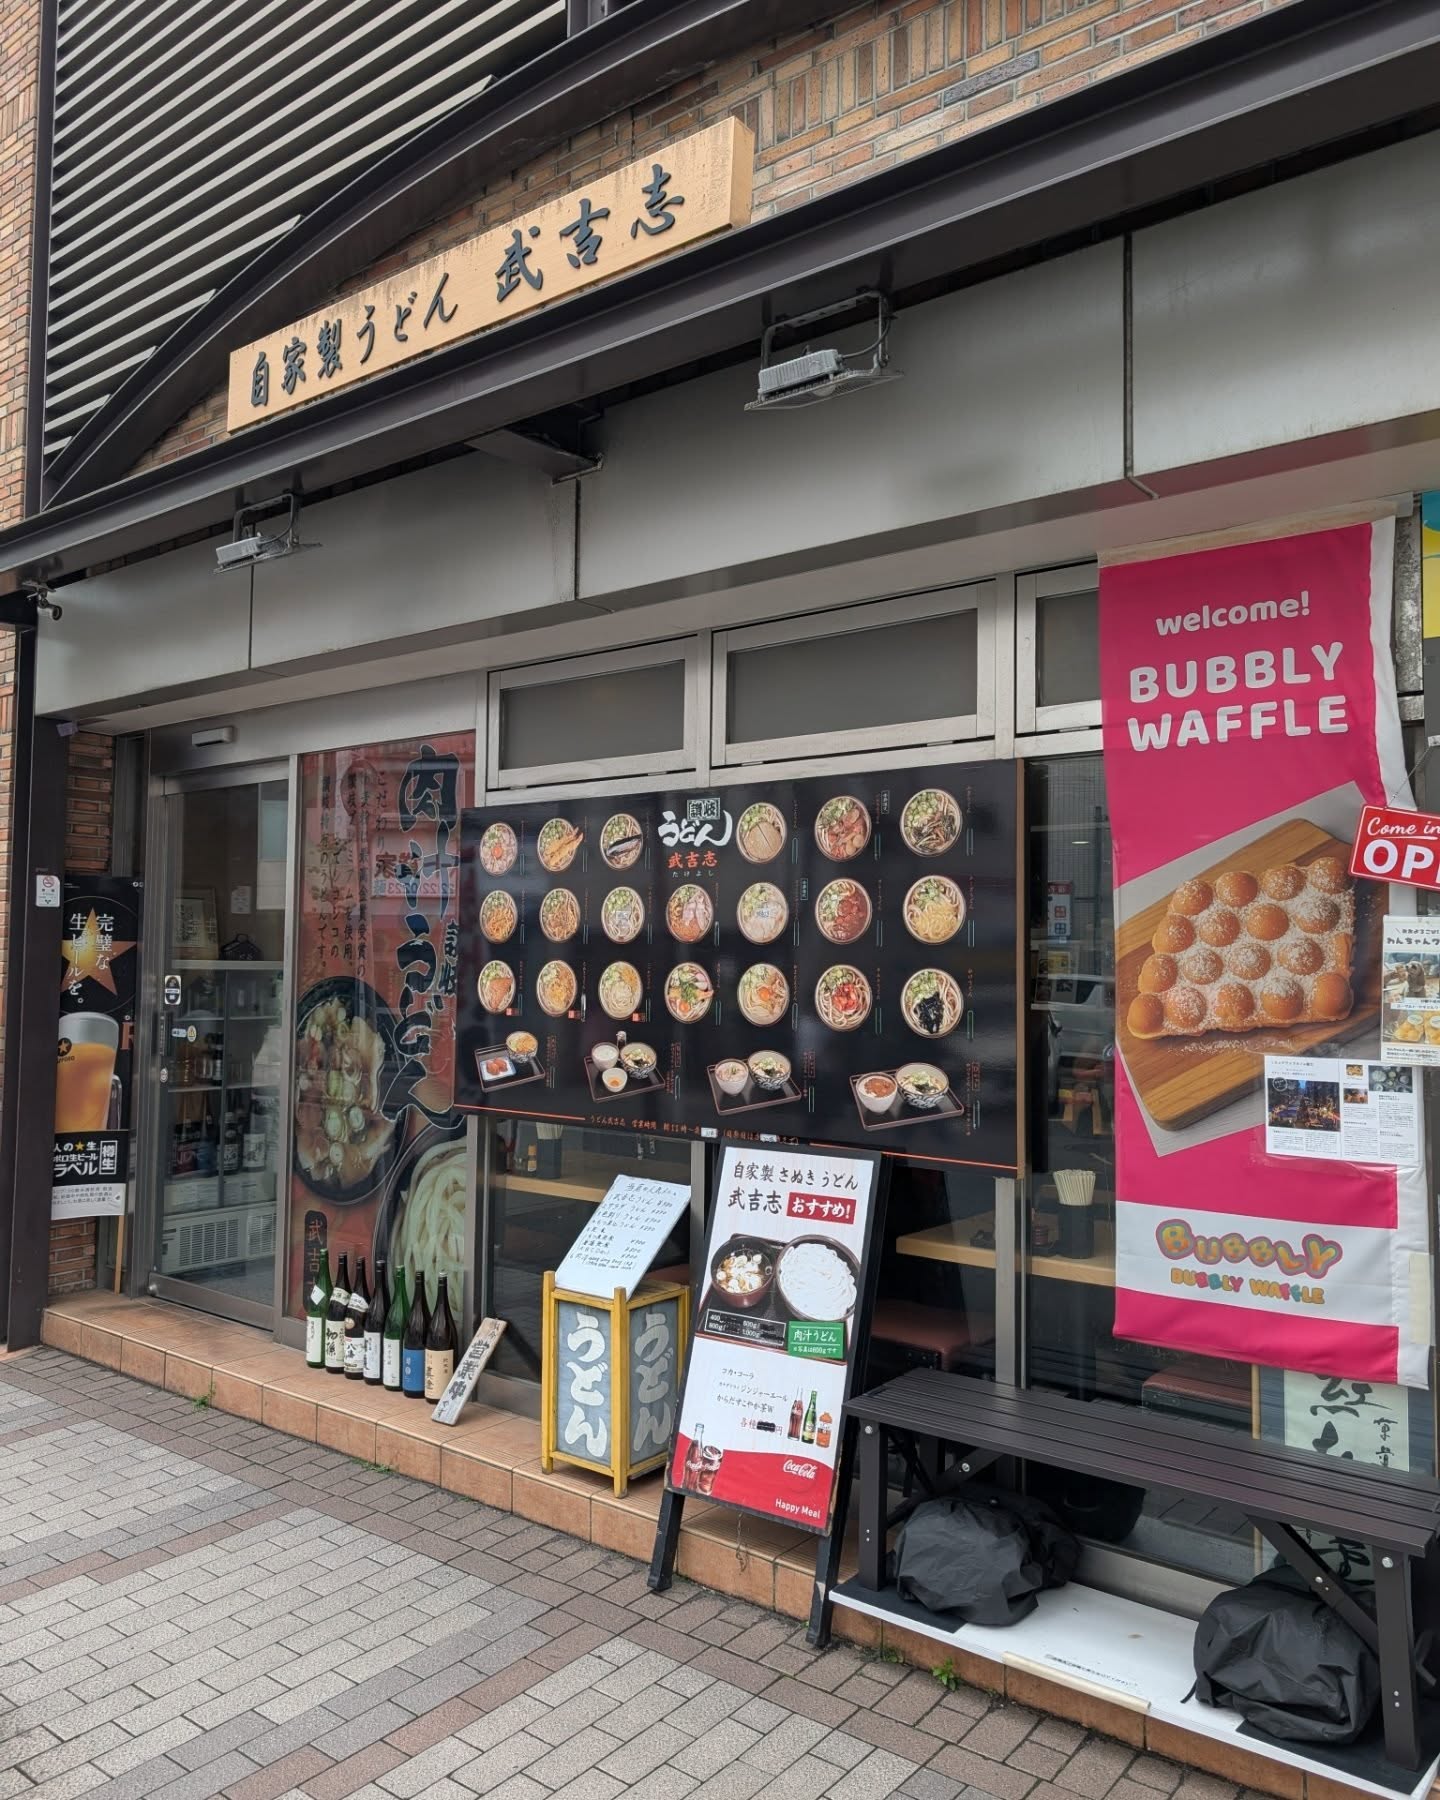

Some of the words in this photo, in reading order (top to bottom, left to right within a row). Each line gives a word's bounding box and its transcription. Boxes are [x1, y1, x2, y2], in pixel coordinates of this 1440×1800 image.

[248, 272, 459, 407] 自家製うどん
[494, 163, 686, 303] 武吉志
[1156, 590, 1311, 636] welcome!
[1129, 641, 1344, 704] BUBBLY
[1127, 694, 1349, 752] WAFFLE
[657, 809, 733, 848] うどん
[1366, 816, 1418, 836] Come
[667, 850, 719, 869] 武吉志
[95, 913, 115, 970] 完璧な
[728, 1186, 783, 1215] 武吉志
[791, 1197, 851, 1219] おすすめ!
[1155, 1218, 1344, 1279] BUBBLY
[1170, 1267, 1244, 1293] BUBBLY
[1250, 1278, 1326, 1305] WAFFLE
[793, 1329, 837, 1343] 肉汁うどん
[564, 1311, 608, 1458] うどん
[633, 1311, 674, 1453] うどん
[775, 1498, 800, 1515] Happy
[801, 1506, 821, 1519] Meal
